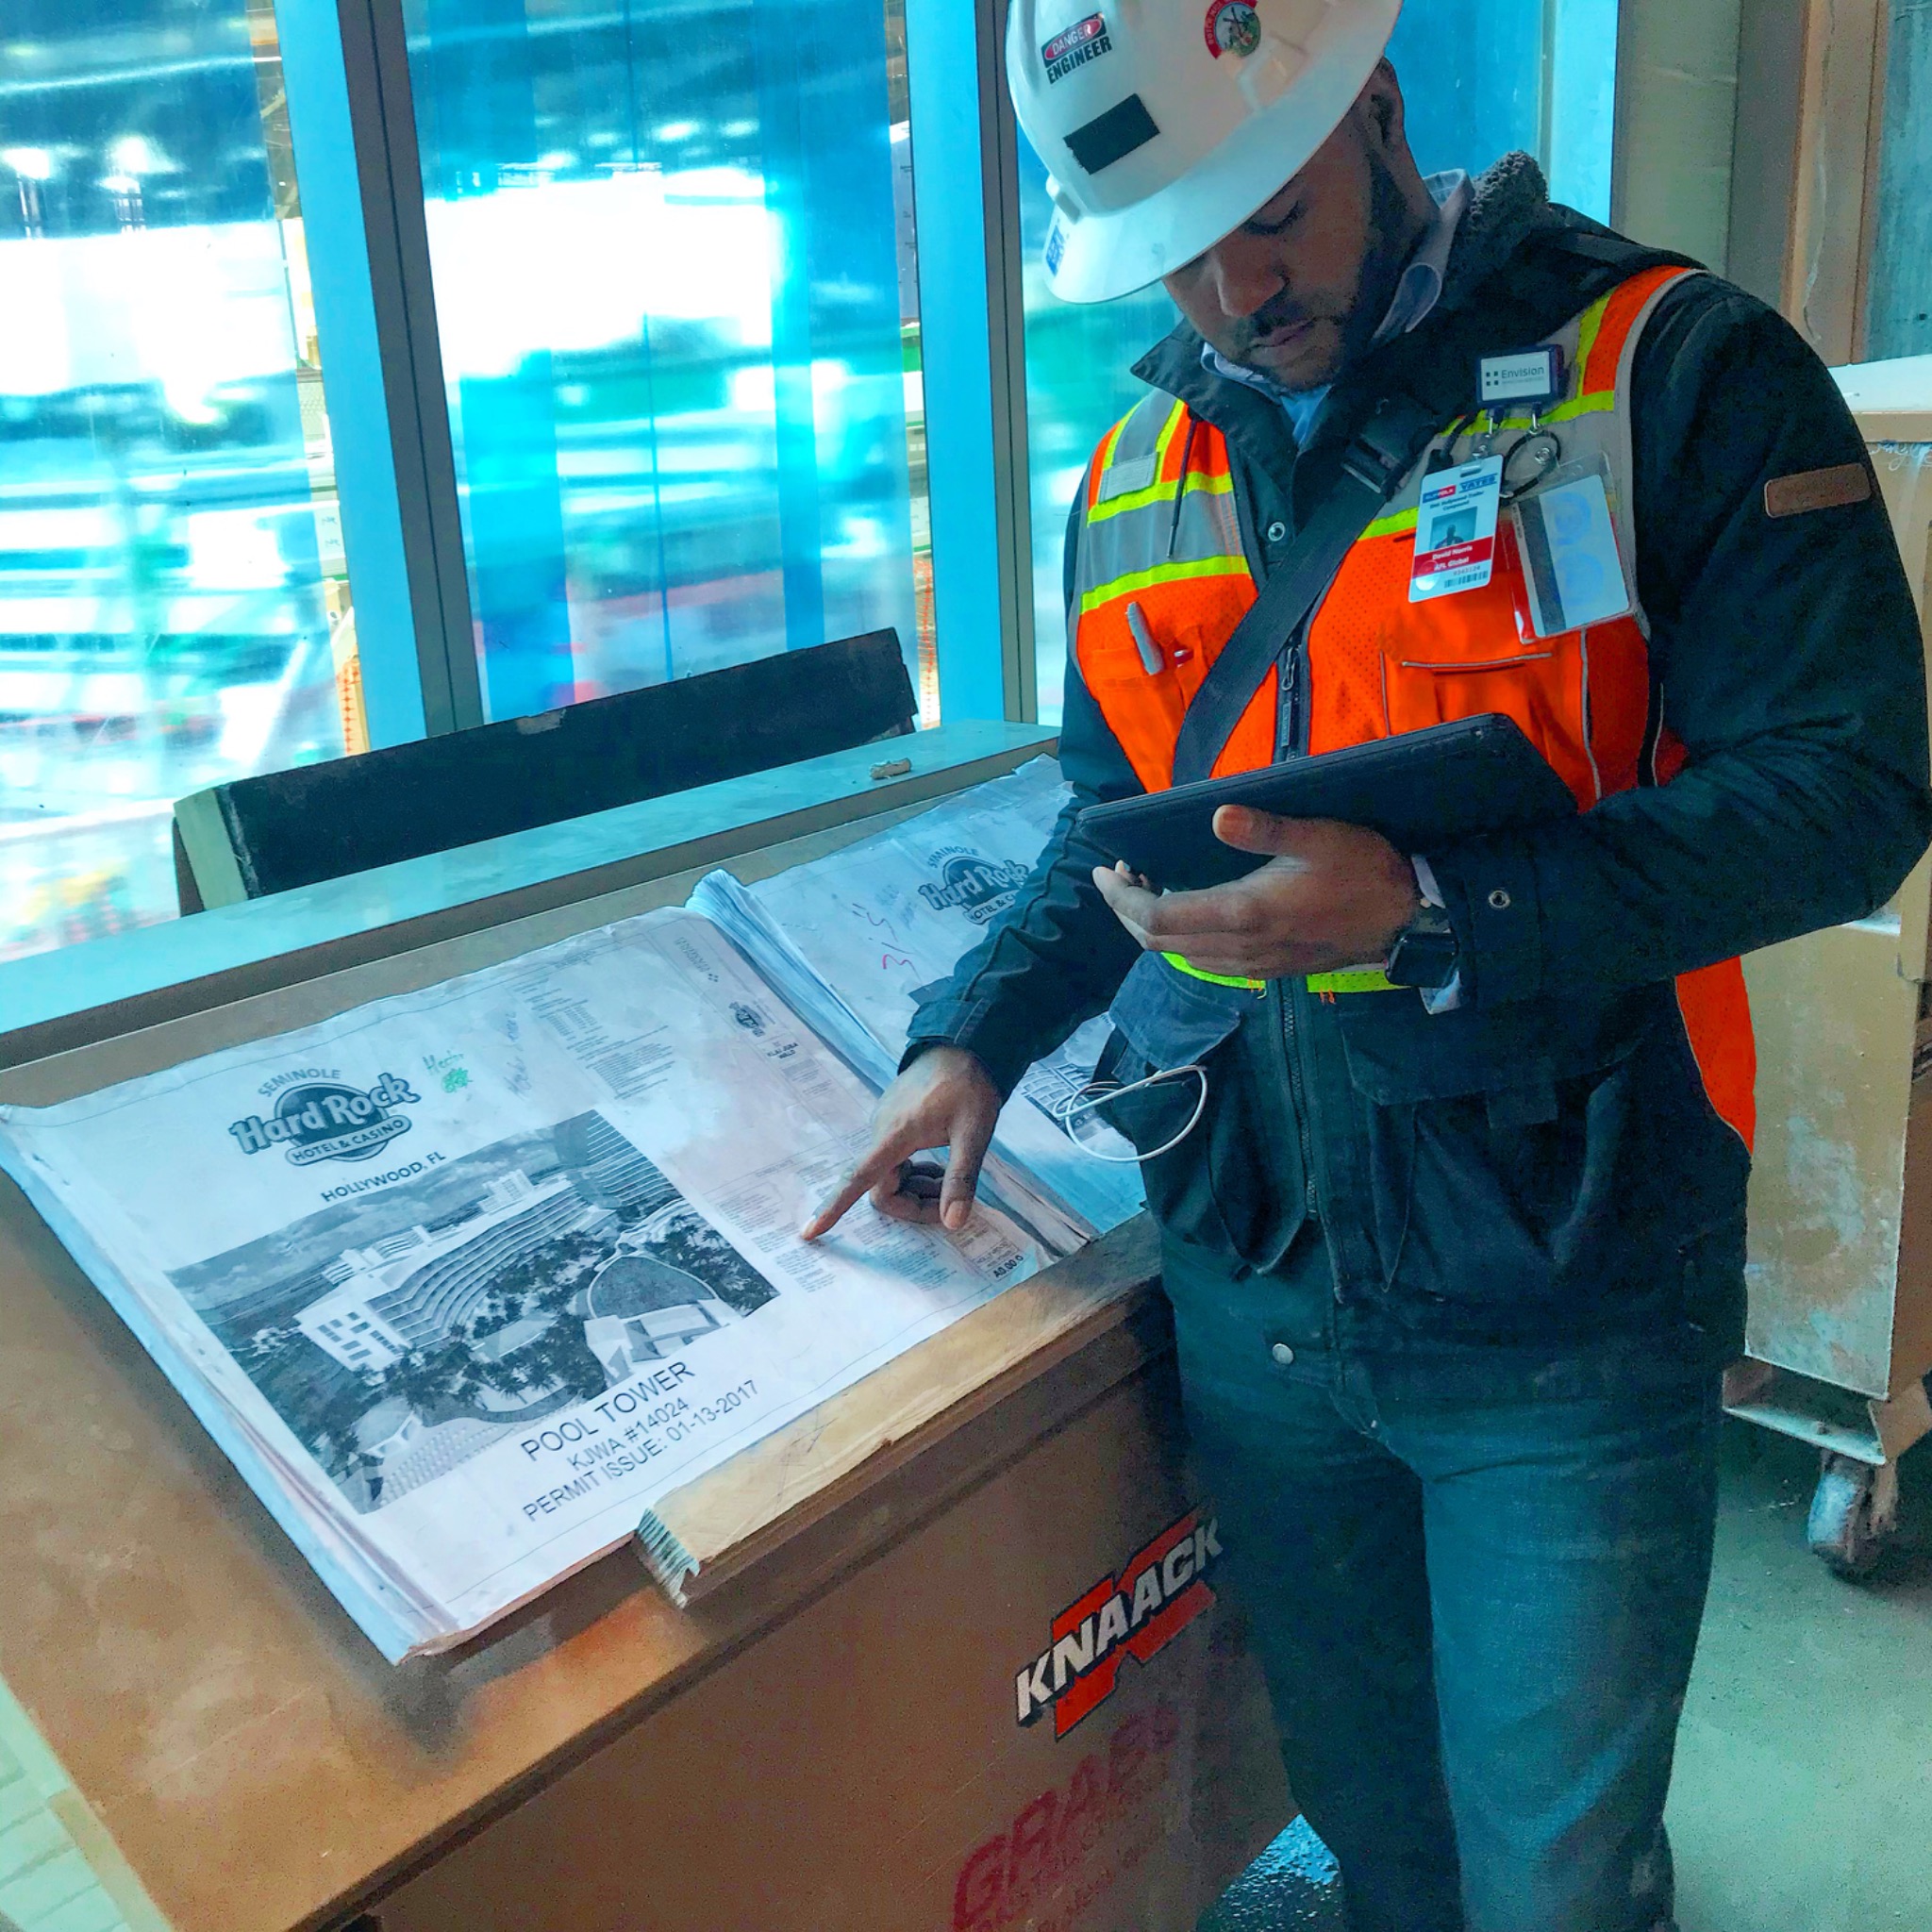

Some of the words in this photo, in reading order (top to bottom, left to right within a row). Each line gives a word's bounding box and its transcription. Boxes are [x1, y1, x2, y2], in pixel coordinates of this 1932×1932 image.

[1046, 36, 1112, 85] ENGINEER
[1052, 24, 1092, 56] DANGER
[1502, 366, 1545, 378] Envision
[918, 869, 985, 911] Hard
[257, 1068, 341, 1098] SEMINOLE
[228, 1100, 329, 1156] Hard
[321, 1072, 422, 1125] Rock
[291, 1142, 338, 1162] HOTEL
[338, 1138, 352, 1149] &
[352, 1118, 405, 1145] CASINO
[425, 1151, 447, 1168] FL
[520, 1416, 599, 1462] POOL
[594, 1360, 696, 1424] TOWER
[566, 1437, 625, 1472] KJWA
[624, 1396, 691, 1443] #14024
[522, 1471, 601, 1522] PERMIT
[600, 1437, 669, 1480] ISSUE:
[665, 1379, 758, 1442] 01-13-2017
[1015, 1516, 1224, 1727] KNAACK
